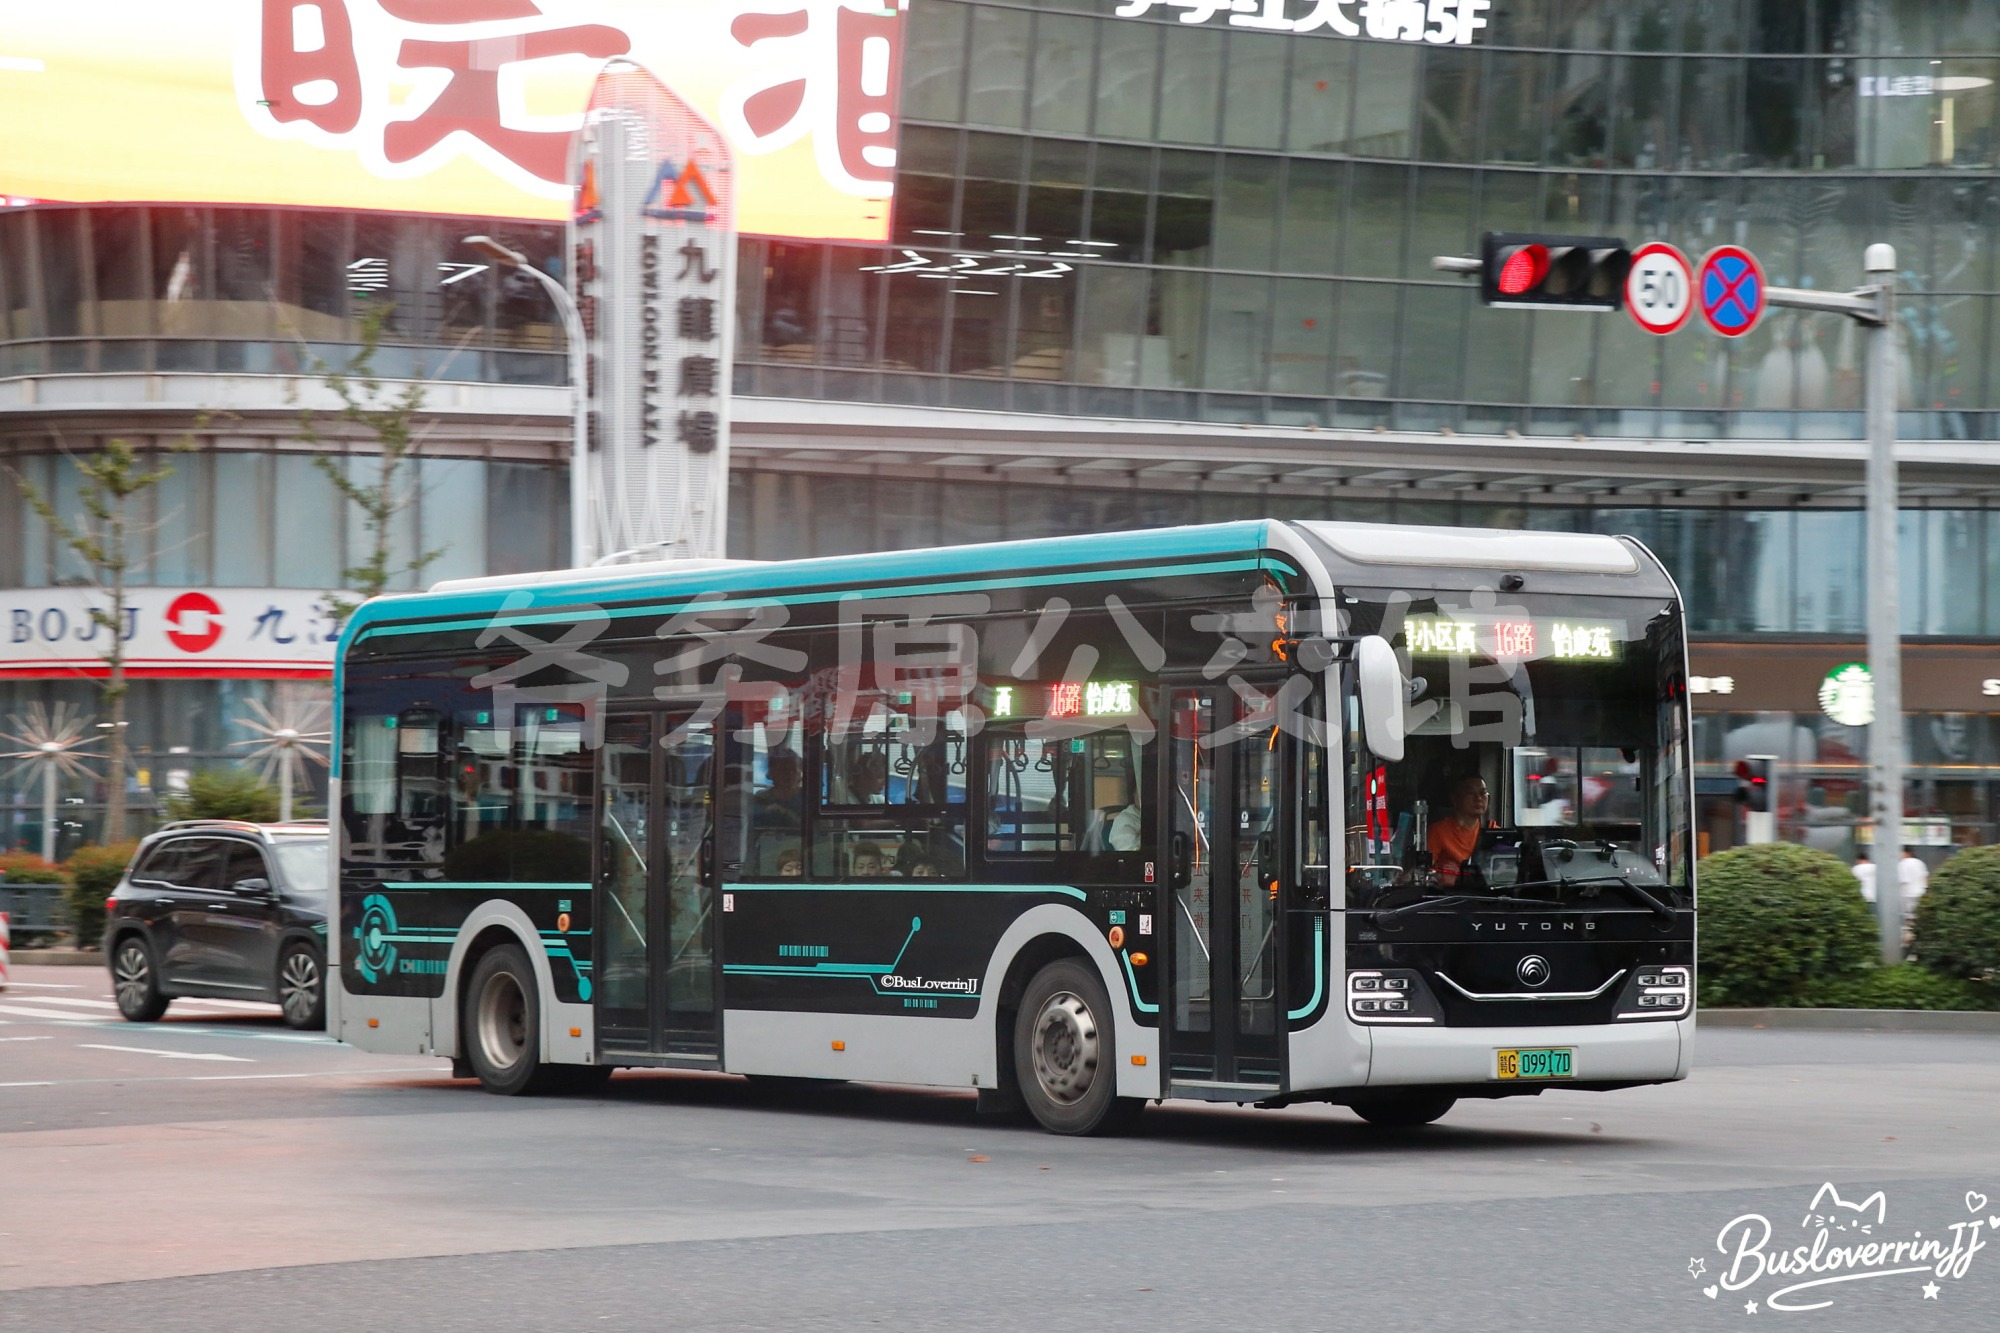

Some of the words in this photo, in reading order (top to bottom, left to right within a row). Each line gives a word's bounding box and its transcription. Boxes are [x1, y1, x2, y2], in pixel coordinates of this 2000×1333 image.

[642, 235, 658, 359] KOWLOON
[1636, 270, 1678, 308] 50
[642, 370, 658, 447] PLAZA
[1494, 622, 1535, 656] 16路
[1051, 683, 1082, 716] 16路
[1471, 922, 1596, 931] YUTONG
